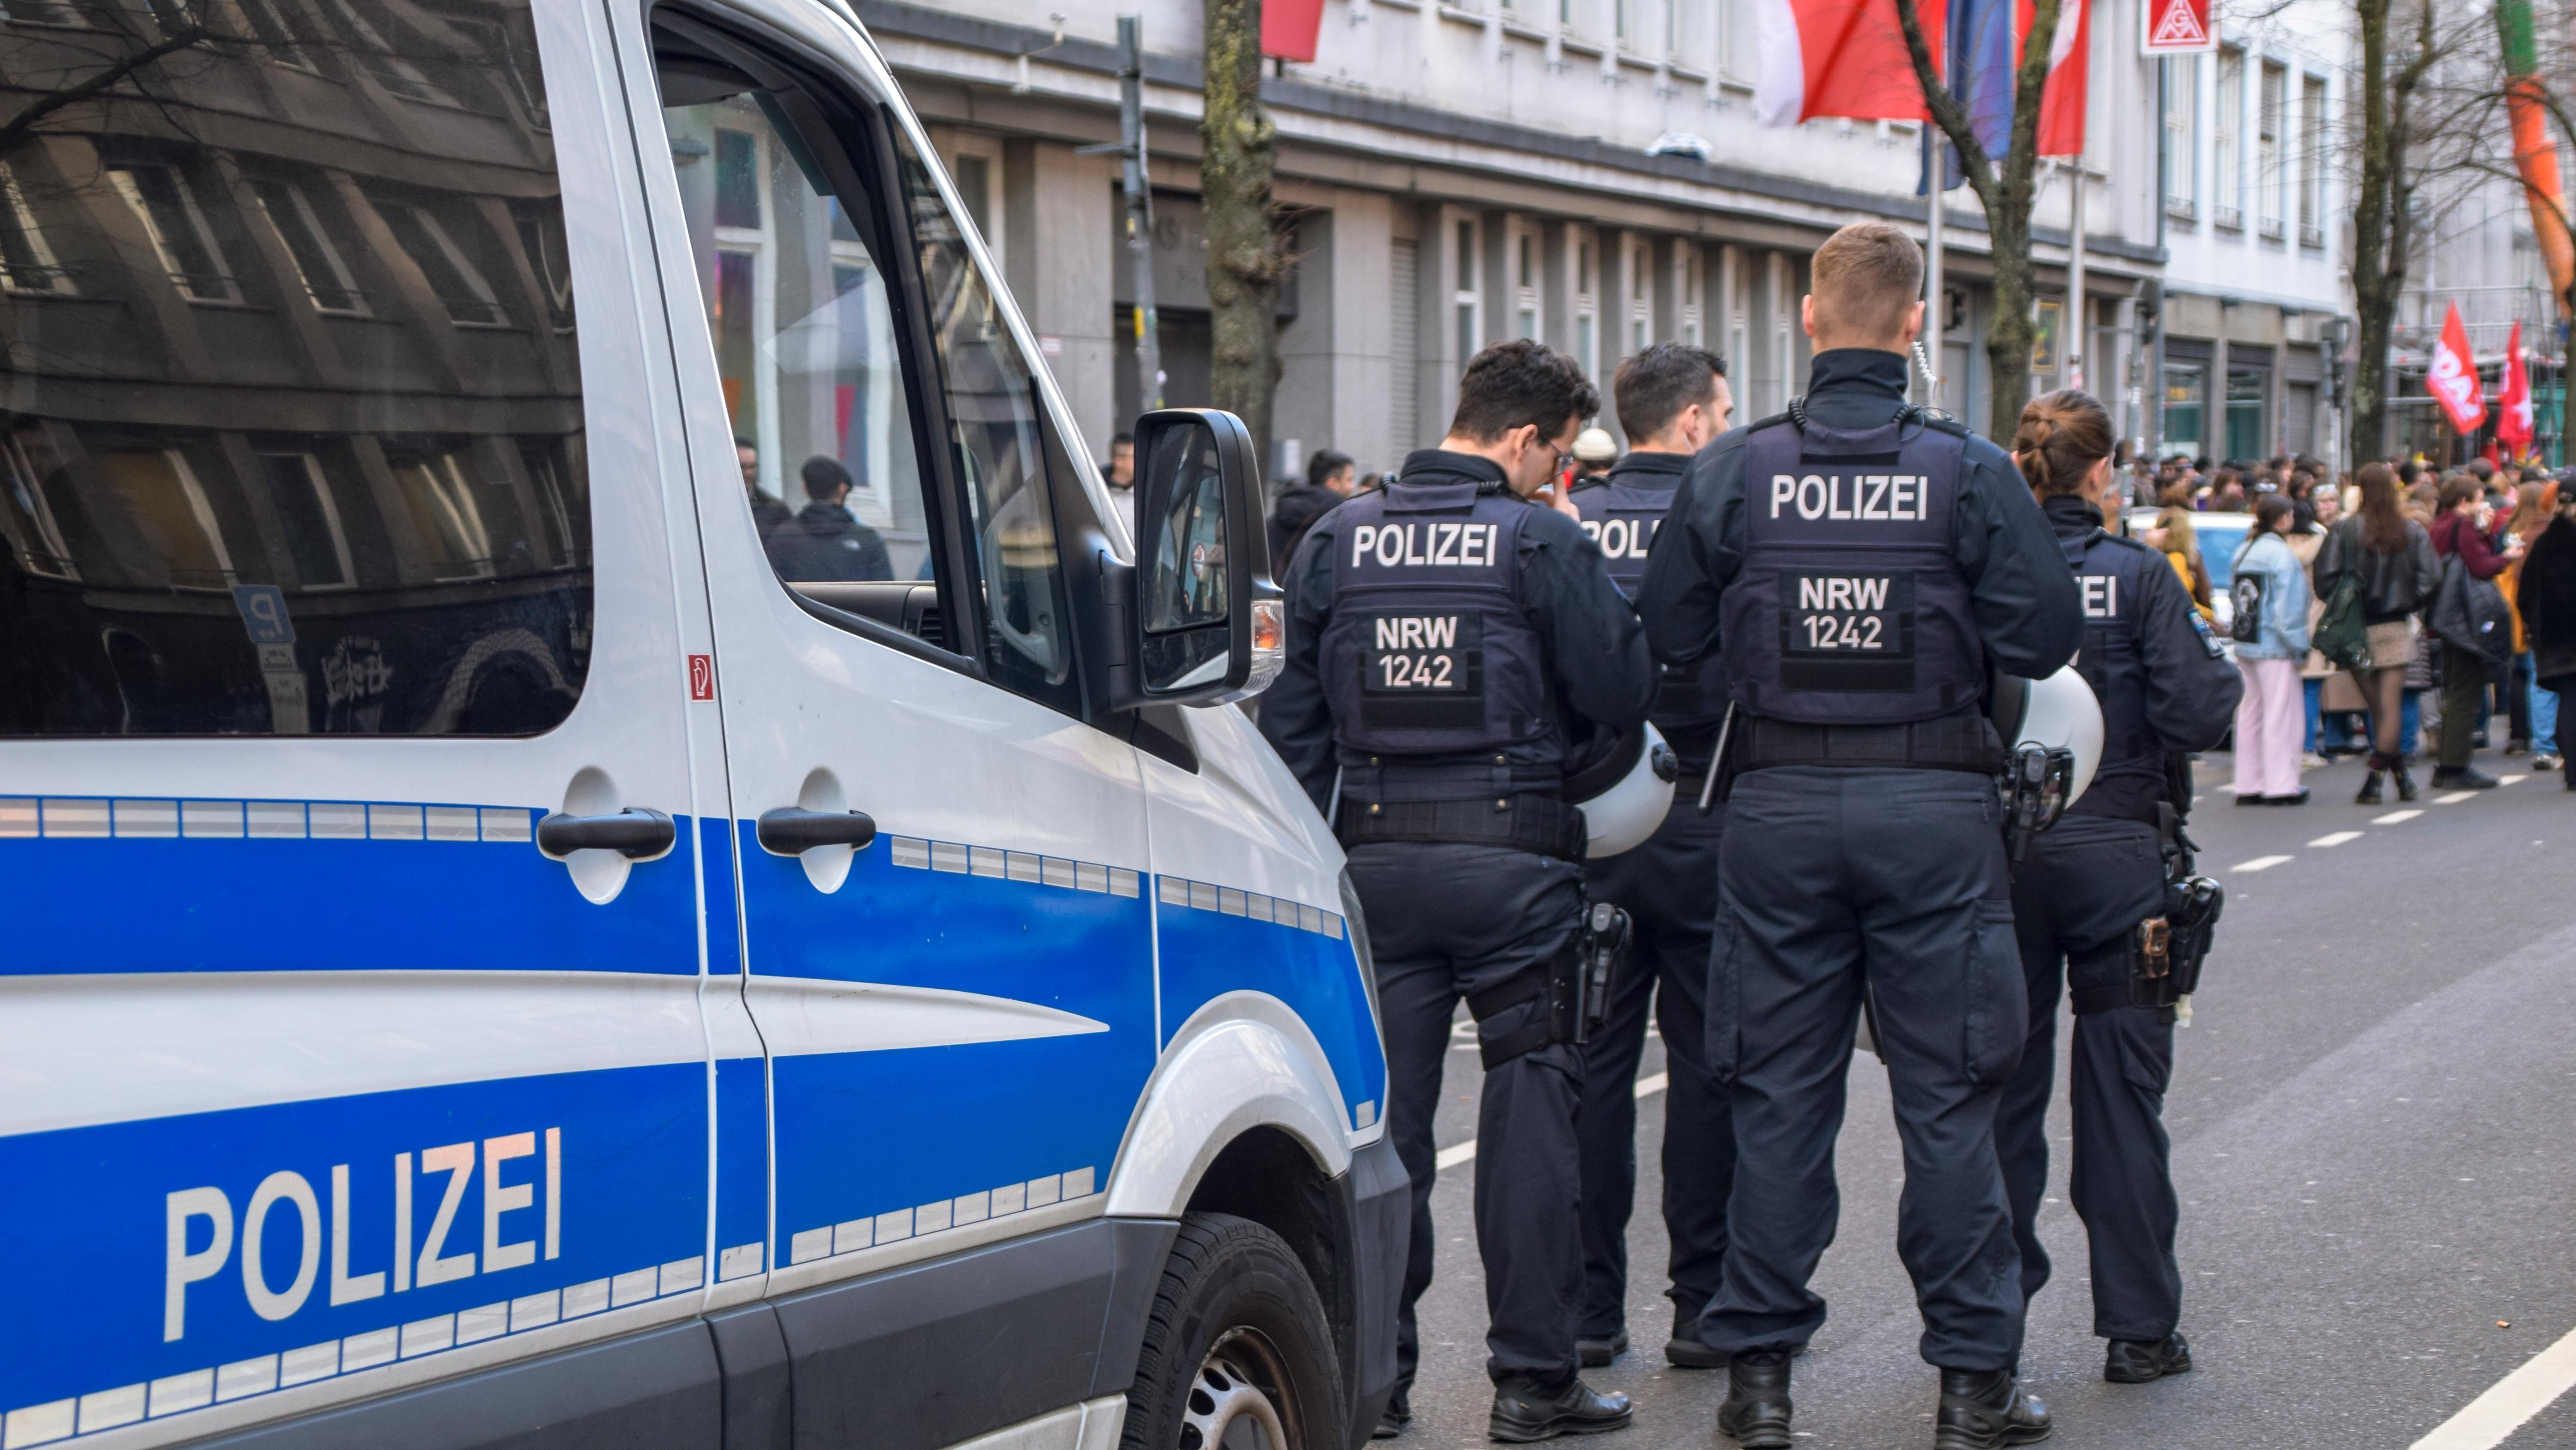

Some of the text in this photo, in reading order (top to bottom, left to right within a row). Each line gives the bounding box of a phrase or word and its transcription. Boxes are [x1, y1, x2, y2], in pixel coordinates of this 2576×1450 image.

[1770, 475, 1928, 521] POLIZEI
[1352, 523, 1497, 567] POLIZEI
[1800, 577, 1889, 610] NRW
[2074, 576, 2116, 616] EI
[1376, 616, 1457, 650] NRW
[1803, 615, 1882, 649] 1242
[1379, 655, 1452, 688] 1242
[164, 1127, 561, 1343] POLIZEI
